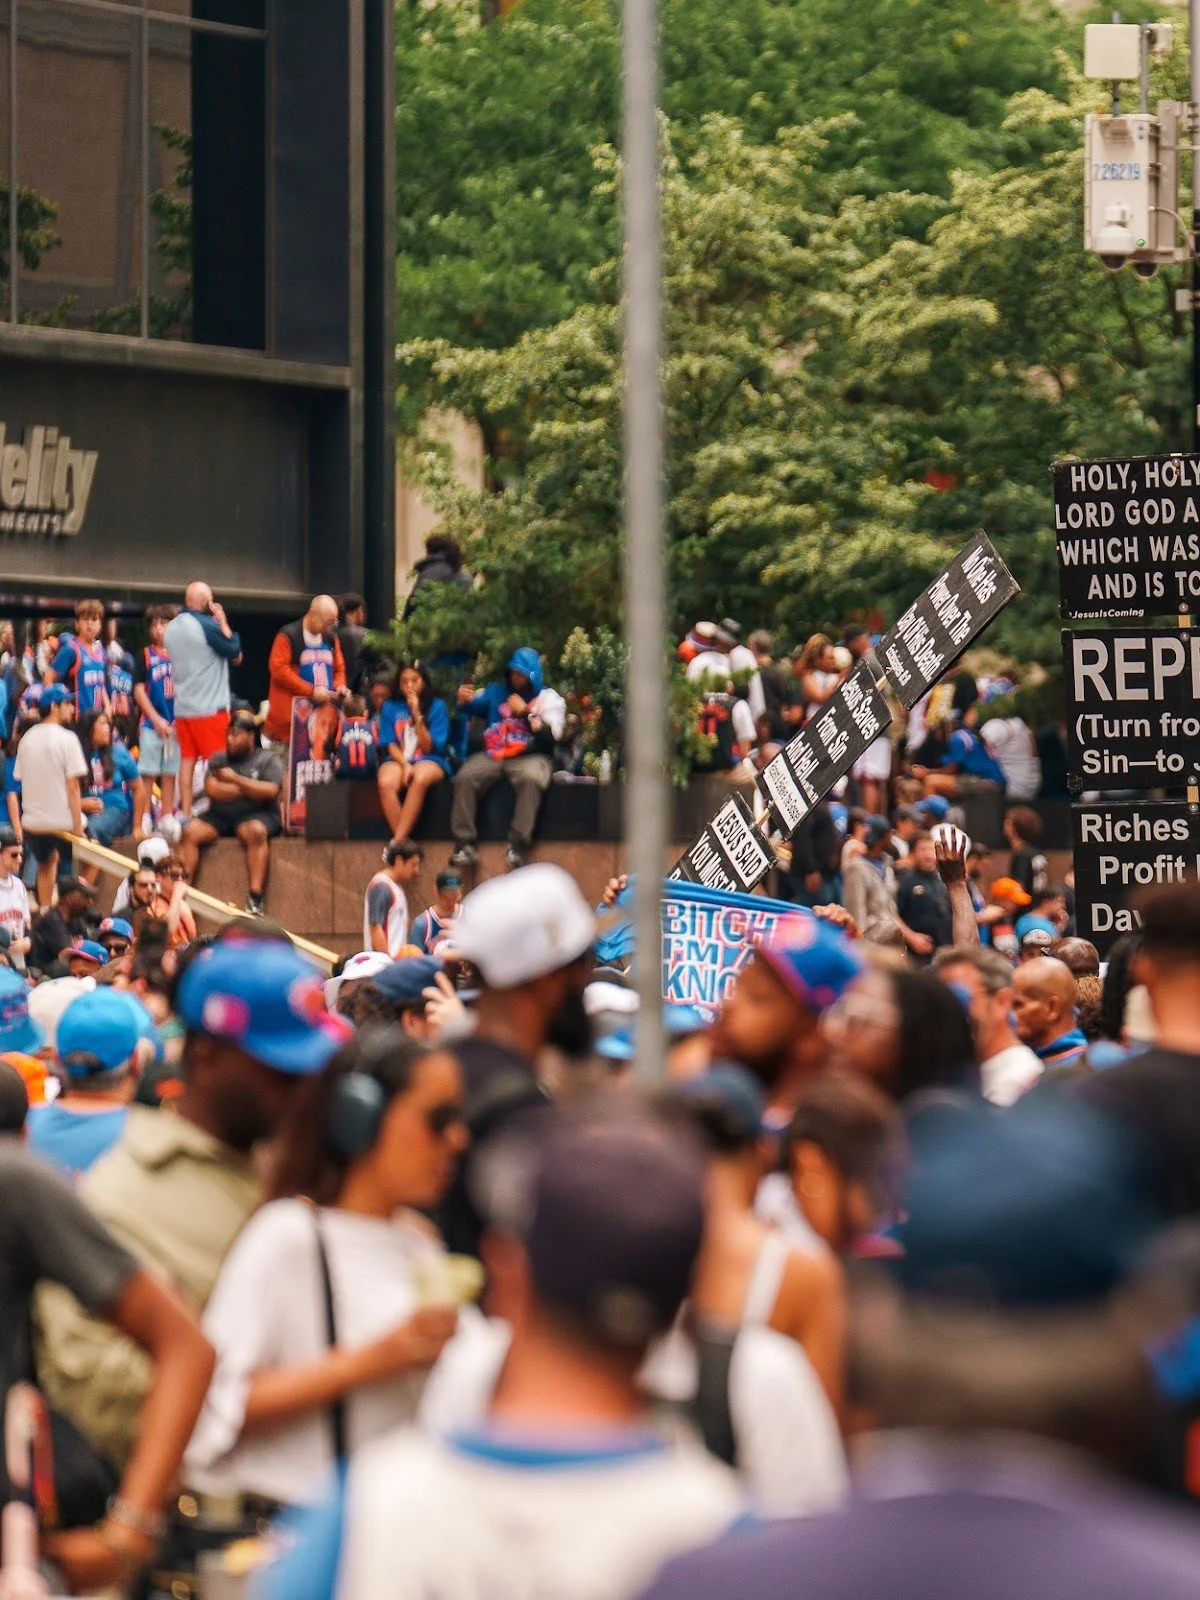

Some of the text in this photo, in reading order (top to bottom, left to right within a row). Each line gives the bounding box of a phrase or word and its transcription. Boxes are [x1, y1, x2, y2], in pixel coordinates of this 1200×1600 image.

[1070, 463, 1137, 494] HOLY,
[1054, 501, 1115, 530] LORD
[1124, 497, 1176, 526] GOD
[1059, 536, 1139, 566] WHICH
[961, 545, 997, 604] No One Has
[1087, 572, 1137, 600] AND
[1145, 571, 1165, 598] IS
[928, 572, 972, 645] Power Over The
[1069, 607, 1145, 620] JesusIsComing
[895, 603, 945, 682] Day Of His Death.
[840, 671, 880, 740] Jesus Saves
[816, 706, 850, 763] From Sin
[1075, 713, 1151, 745] (Turn
[785, 731, 811, 764] And
[716, 810, 747, 851] JESUS
[735, 841, 763, 878] SAID
[1081, 812, 1189, 843] Riches
[1099, 854, 1186, 885] Profit
[661, 902, 777, 945] BITCH
[662, 963, 738, 1003] KNIC
